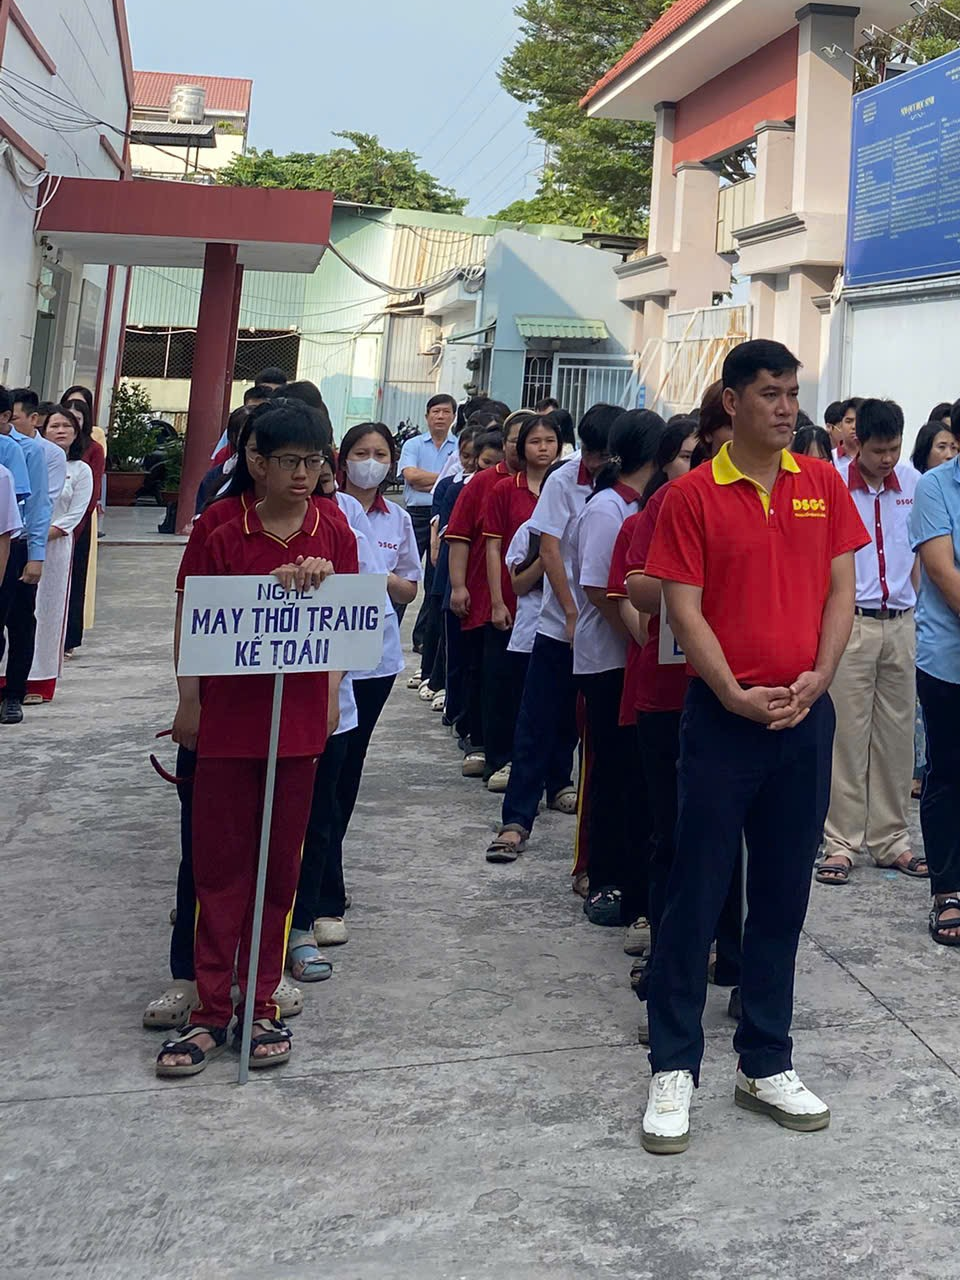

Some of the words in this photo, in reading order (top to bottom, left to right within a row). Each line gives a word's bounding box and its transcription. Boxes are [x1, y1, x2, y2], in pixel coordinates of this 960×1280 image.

[792, 498, 826, 511] DSGC
[191, 608, 244, 634] MAY
[252, 601, 300, 633] THỜI
[307, 605, 379, 632] TRANG
[235, 633, 264, 667] KẾ
[270, 633, 329, 666] TOÁN
